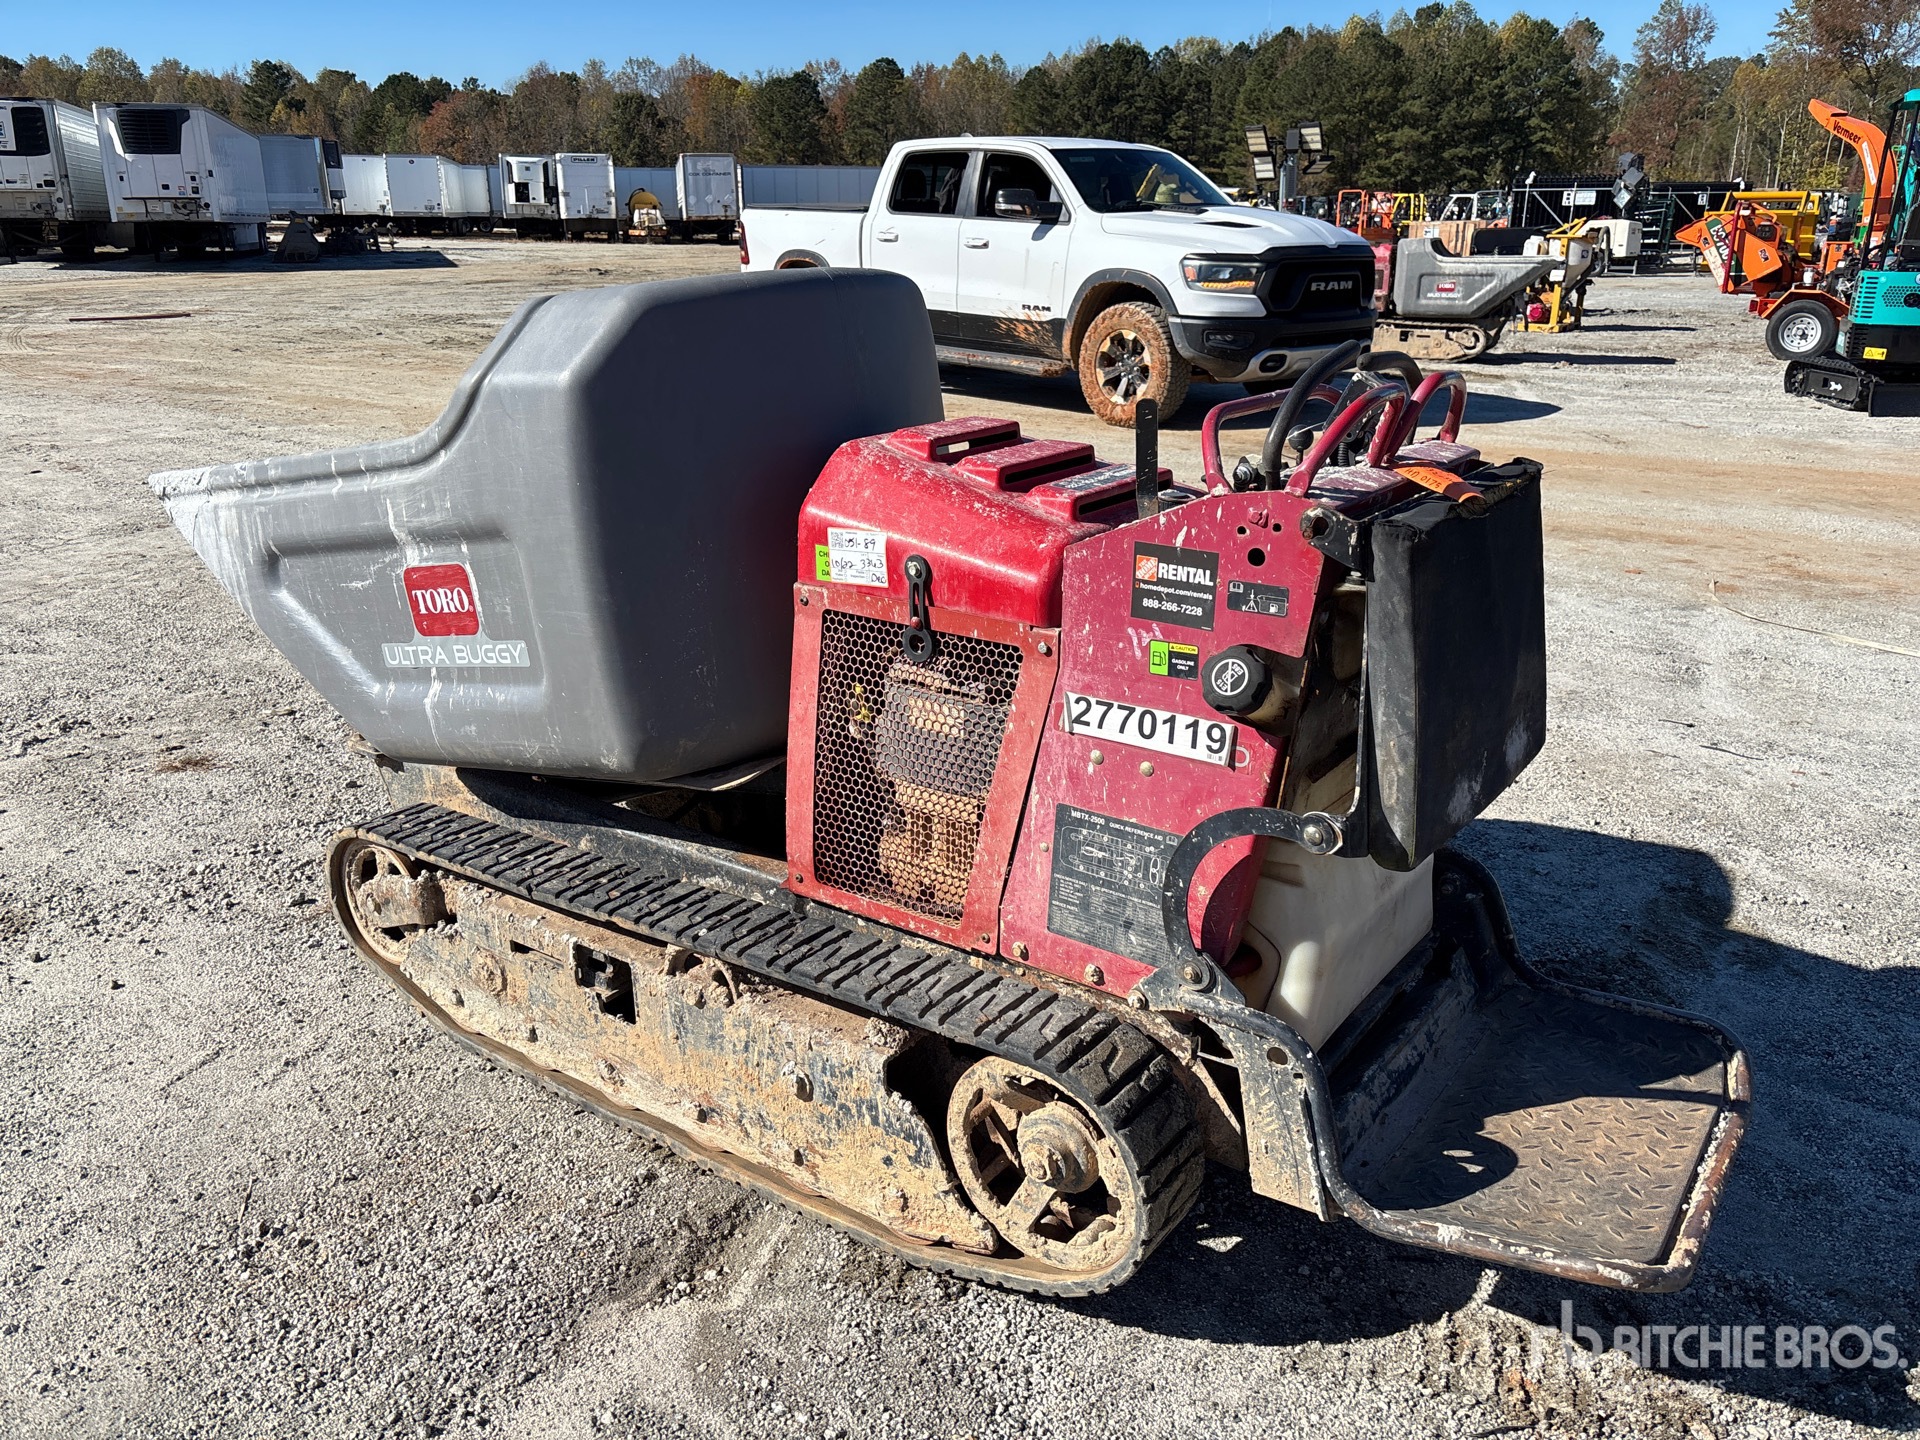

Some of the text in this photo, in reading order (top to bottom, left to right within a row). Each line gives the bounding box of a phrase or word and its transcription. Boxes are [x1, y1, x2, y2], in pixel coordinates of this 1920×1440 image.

[1832, 119, 1862, 144] Vermeer
[1310, 280, 1353, 291] RAM
[1021, 303, 1052, 312] RAM
[1158, 563, 1214, 586] RENTAL
[411, 586, 469, 614] TORO
[1139, 582, 1213, 600] homedepot.com/rentals
[1142, 597, 1203, 617] 888-266-7228
[384, 644, 521, 665] ULTRA BUGGY
[1171, 658, 1195, 666] GASOLINE
[1071, 696, 1227, 755] 2770119
[1070, 808, 1106, 826] MBTX-2500
